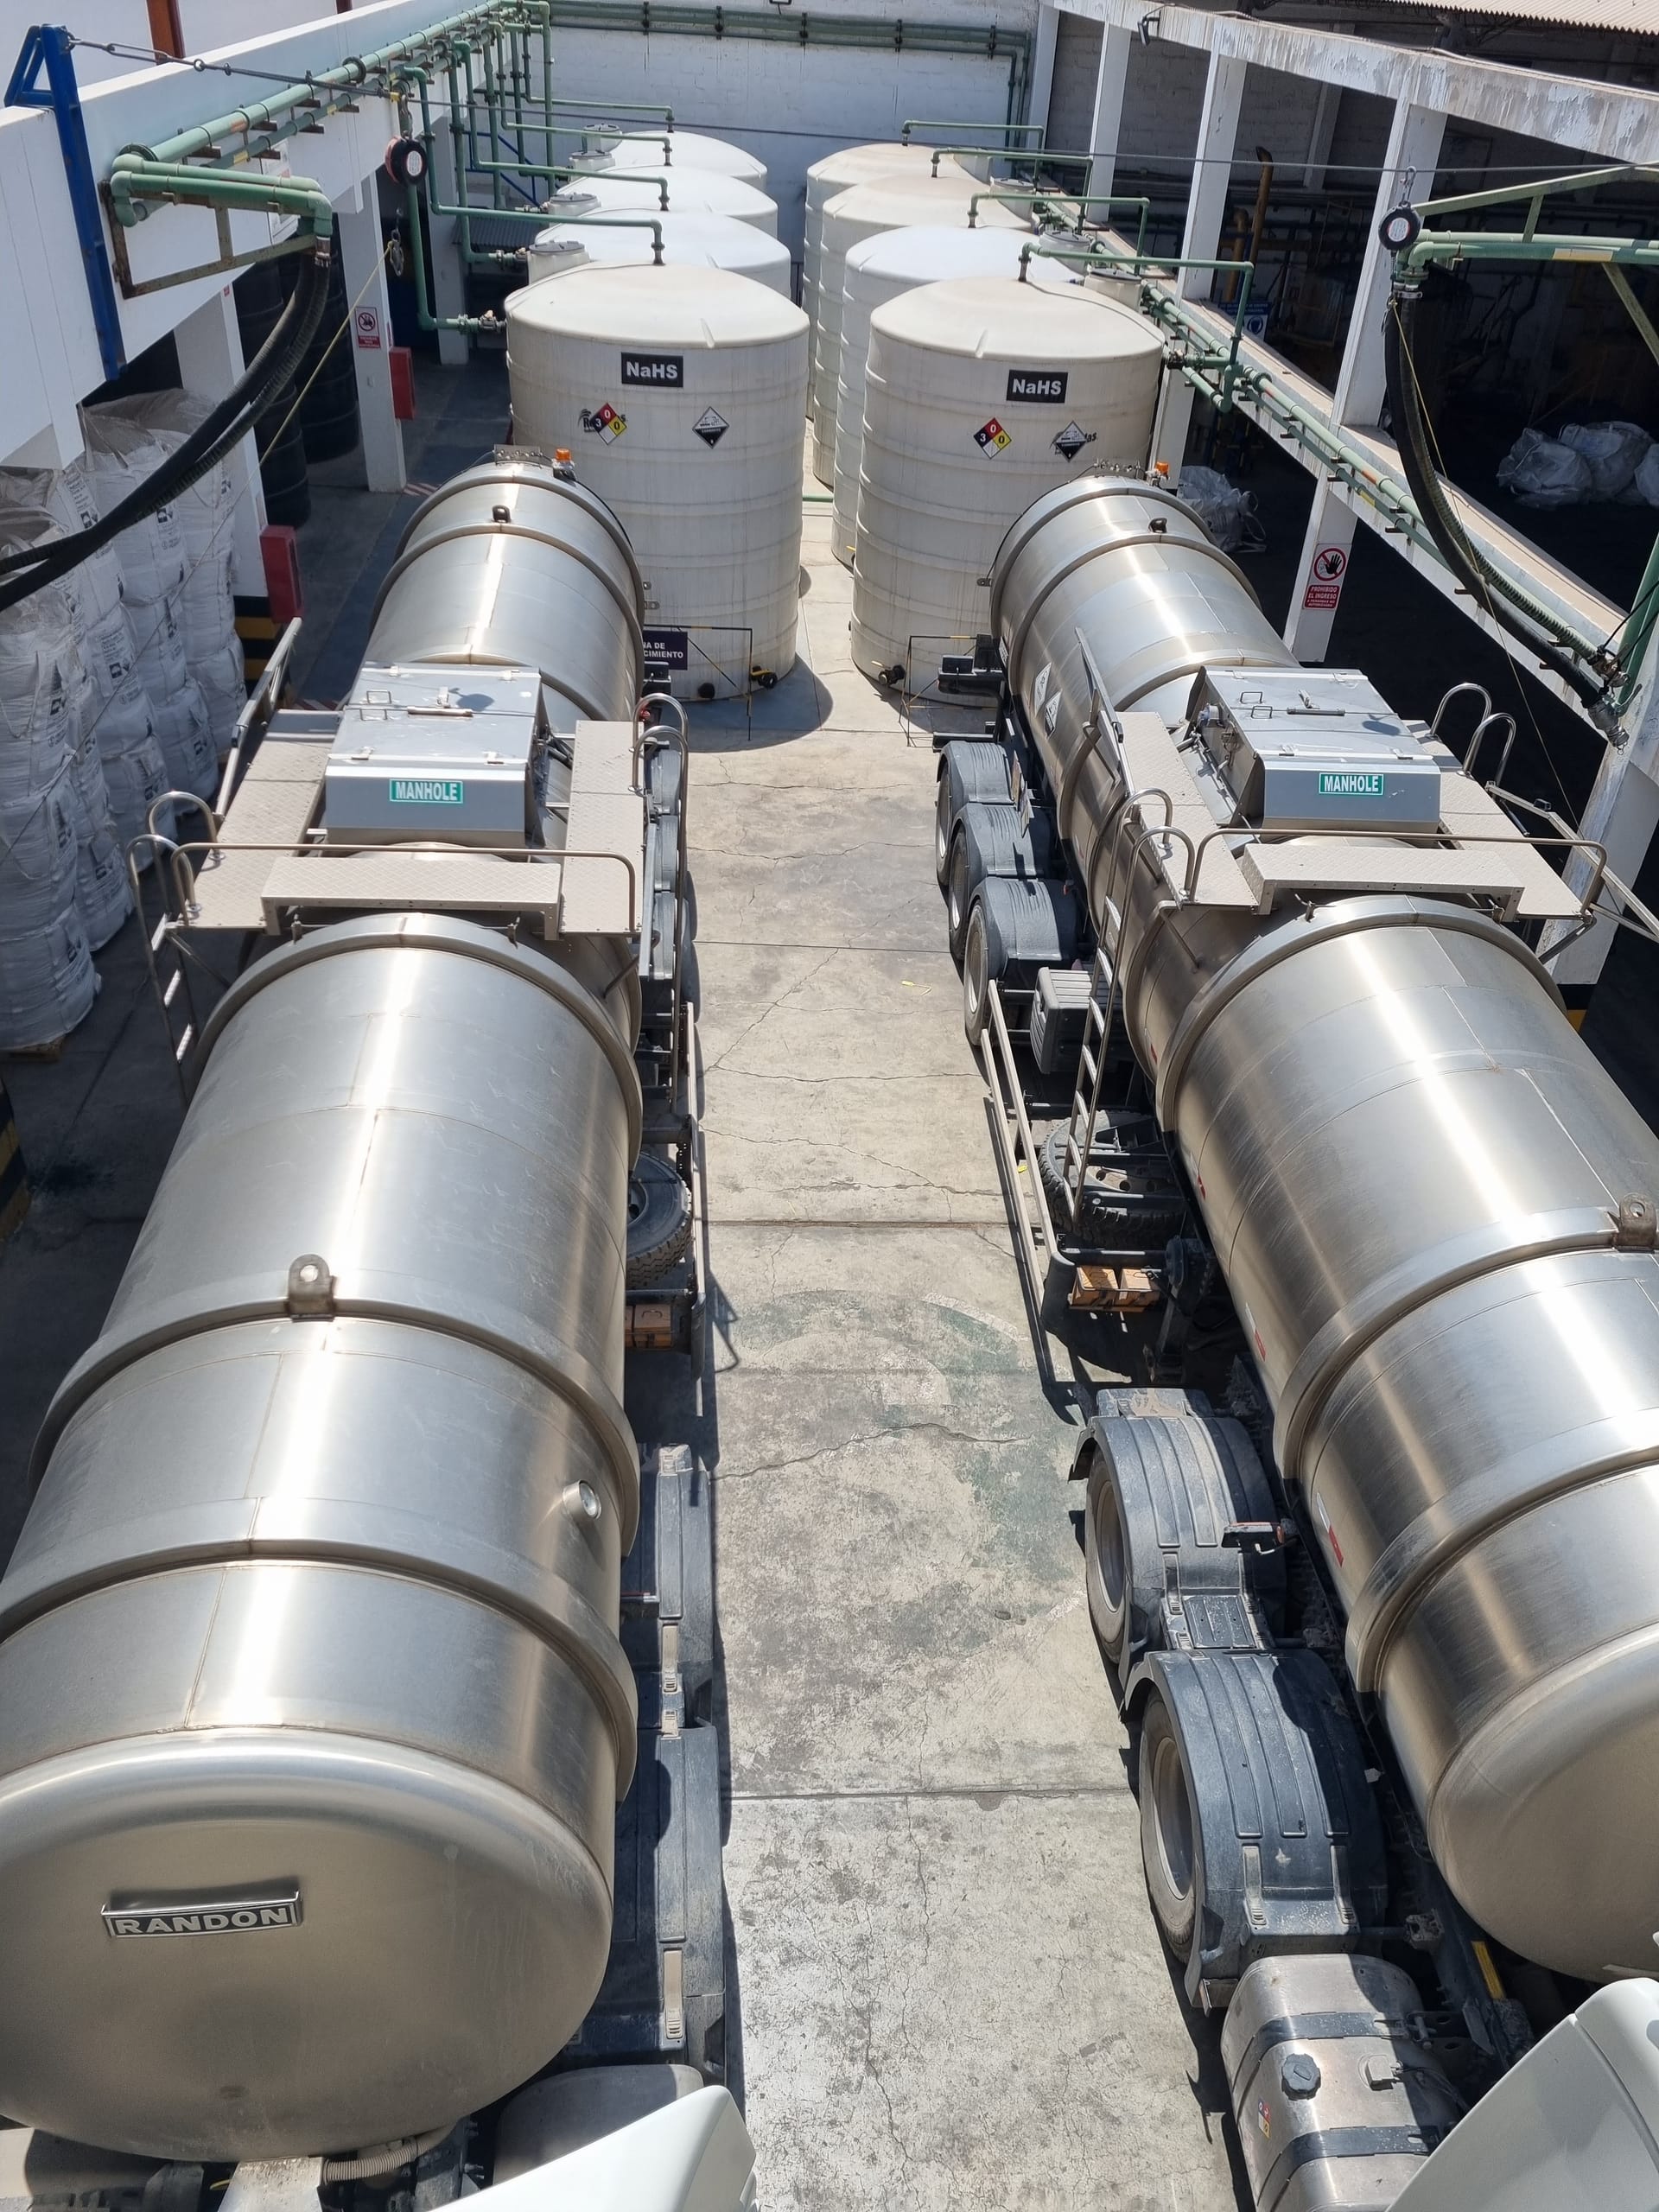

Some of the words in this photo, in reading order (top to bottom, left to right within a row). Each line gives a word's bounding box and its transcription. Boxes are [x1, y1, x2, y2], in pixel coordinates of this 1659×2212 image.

[626, 361, 678, 379] NaHS
[1012, 378, 1062, 395] NaHS
[604, 410, 611, 419] 0
[595, 417, 601, 427] 3
[613, 421, 620, 430] 0
[990, 424, 996, 433] 0
[980, 433, 986, 442] 3
[998, 435, 1005, 444] 0
[644, 650, 683, 658] CIMIENTO
[1324, 775, 1379, 792] MANHOLE
[395, 781, 458, 801] MANHOLE
[114, 1907, 289, 1934] RANDON
